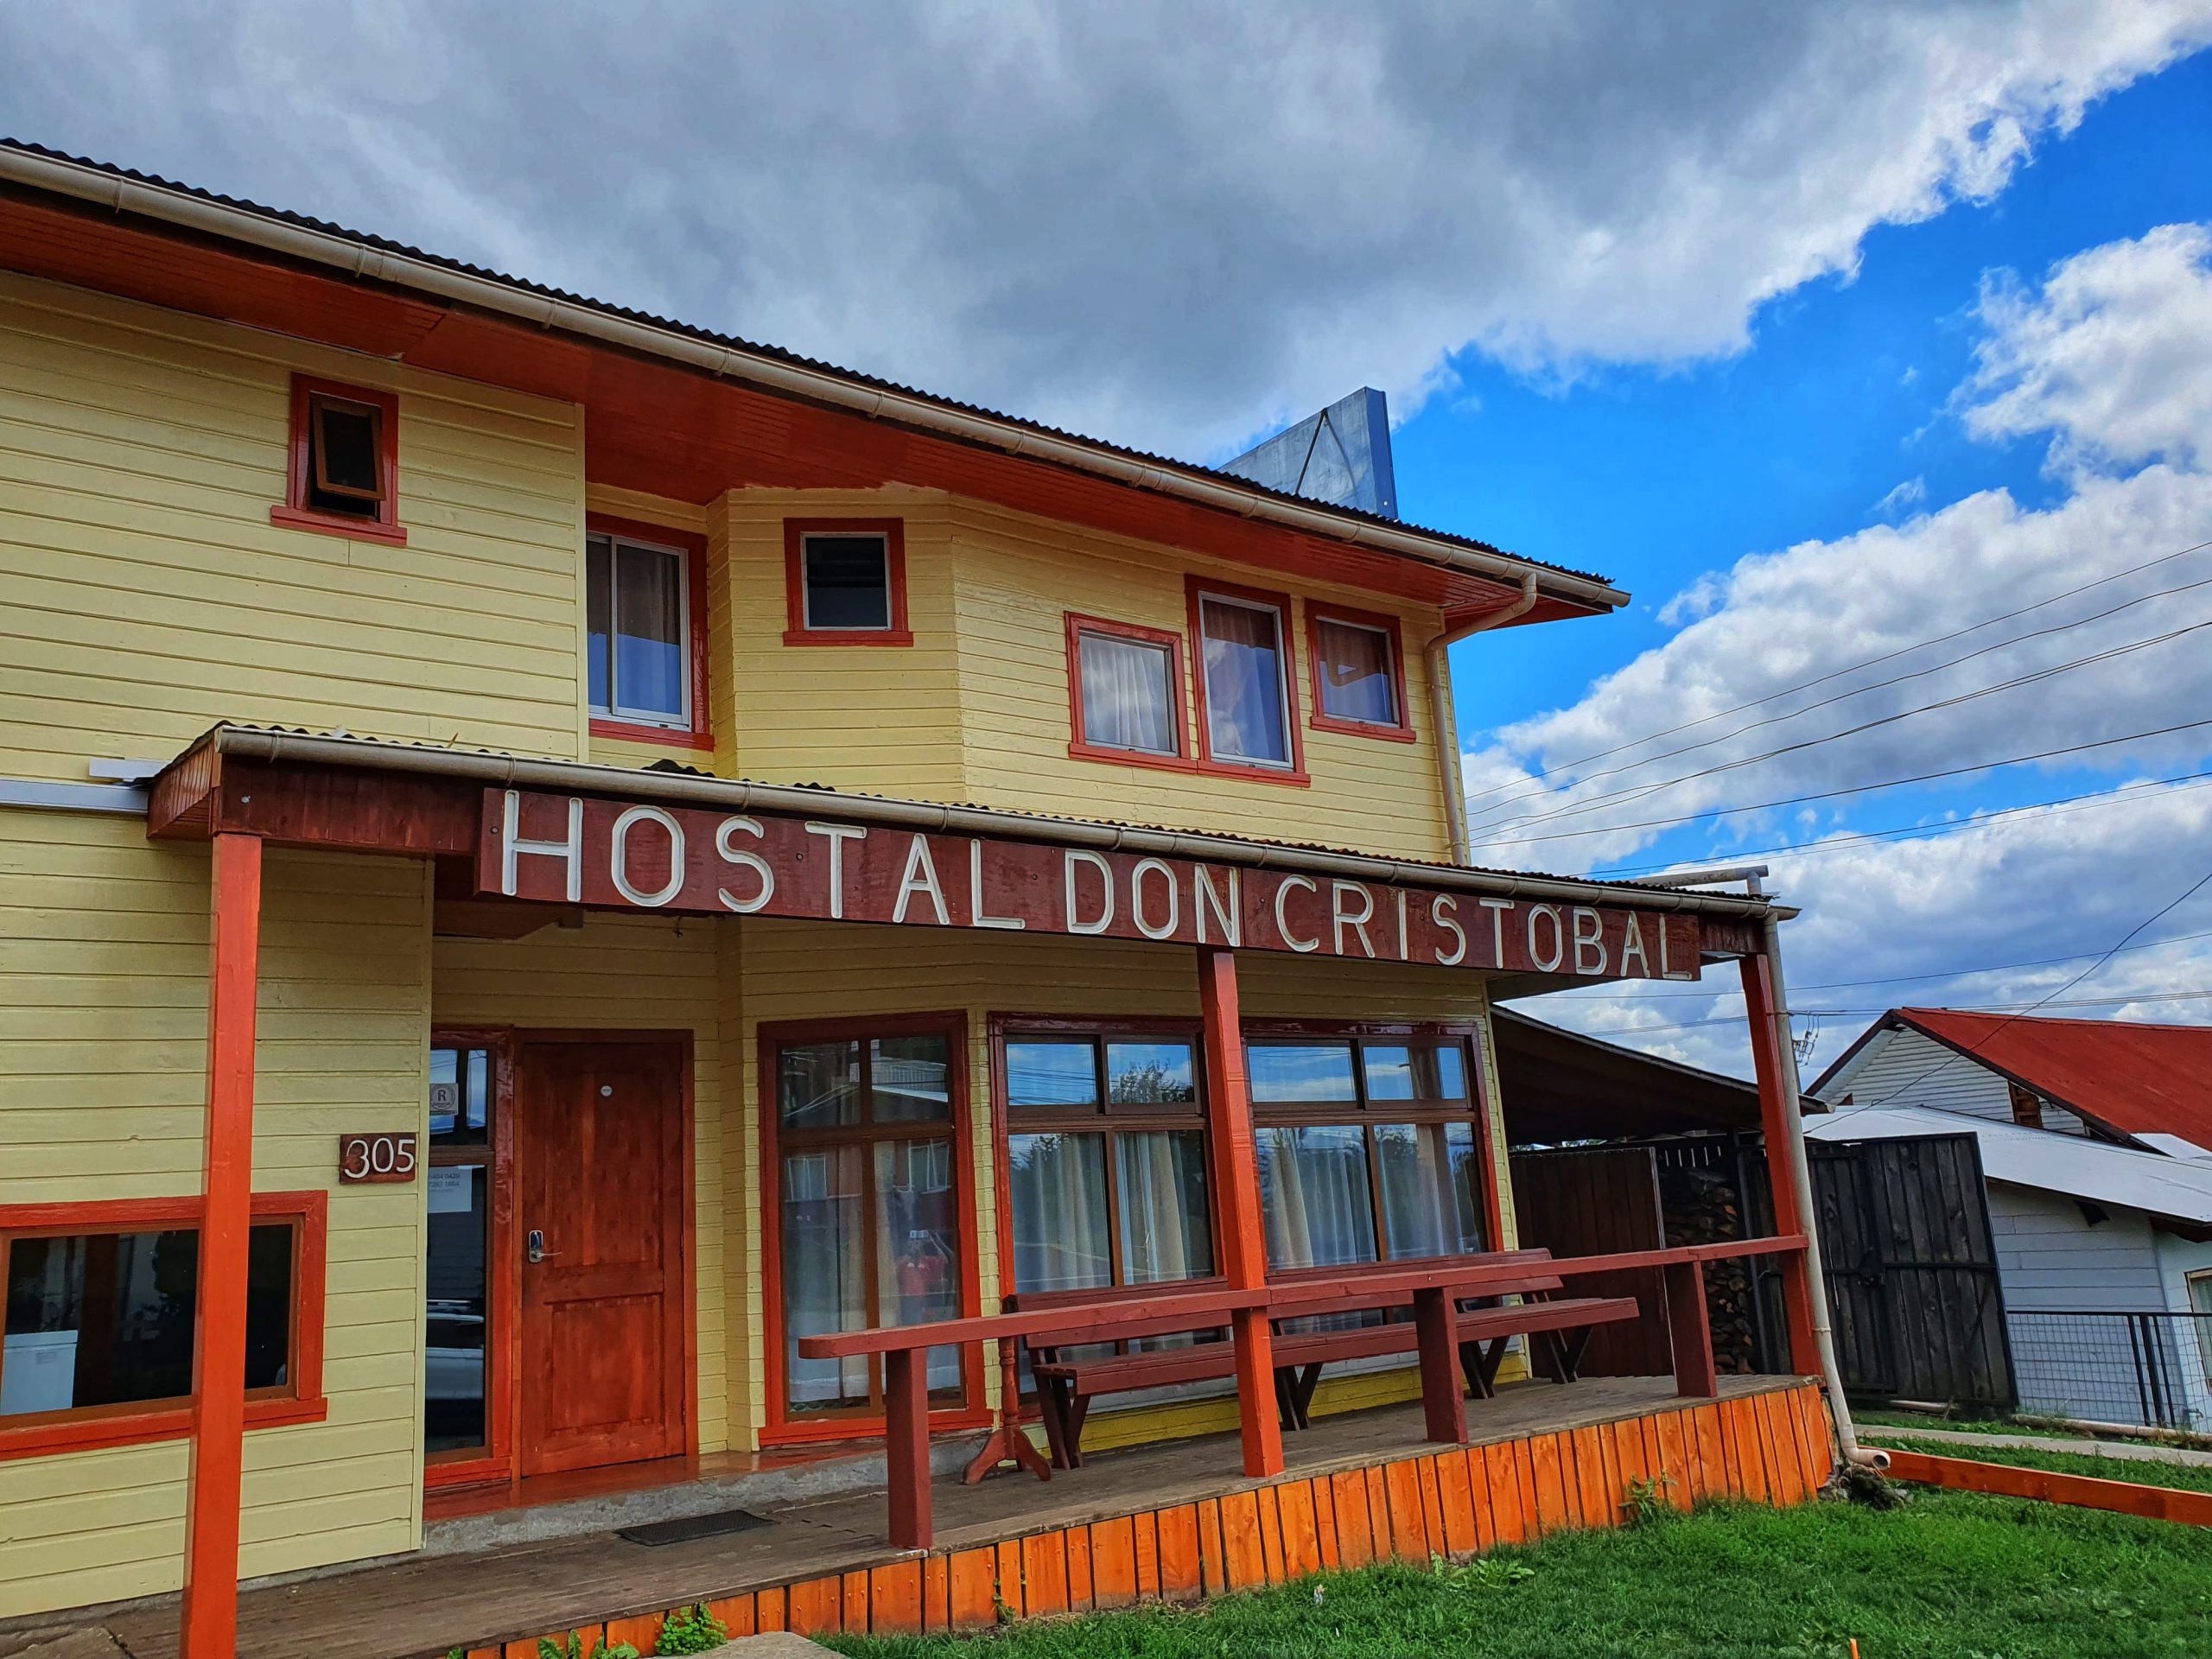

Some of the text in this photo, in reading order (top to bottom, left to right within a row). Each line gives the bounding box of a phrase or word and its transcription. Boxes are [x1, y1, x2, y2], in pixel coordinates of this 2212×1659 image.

[501, 789, 1026, 930] HOSTAL
[1065, 849, 1240, 947] DON
[437, 1089, 447, 1102] R
[345, 1137, 416, 1179] 305
